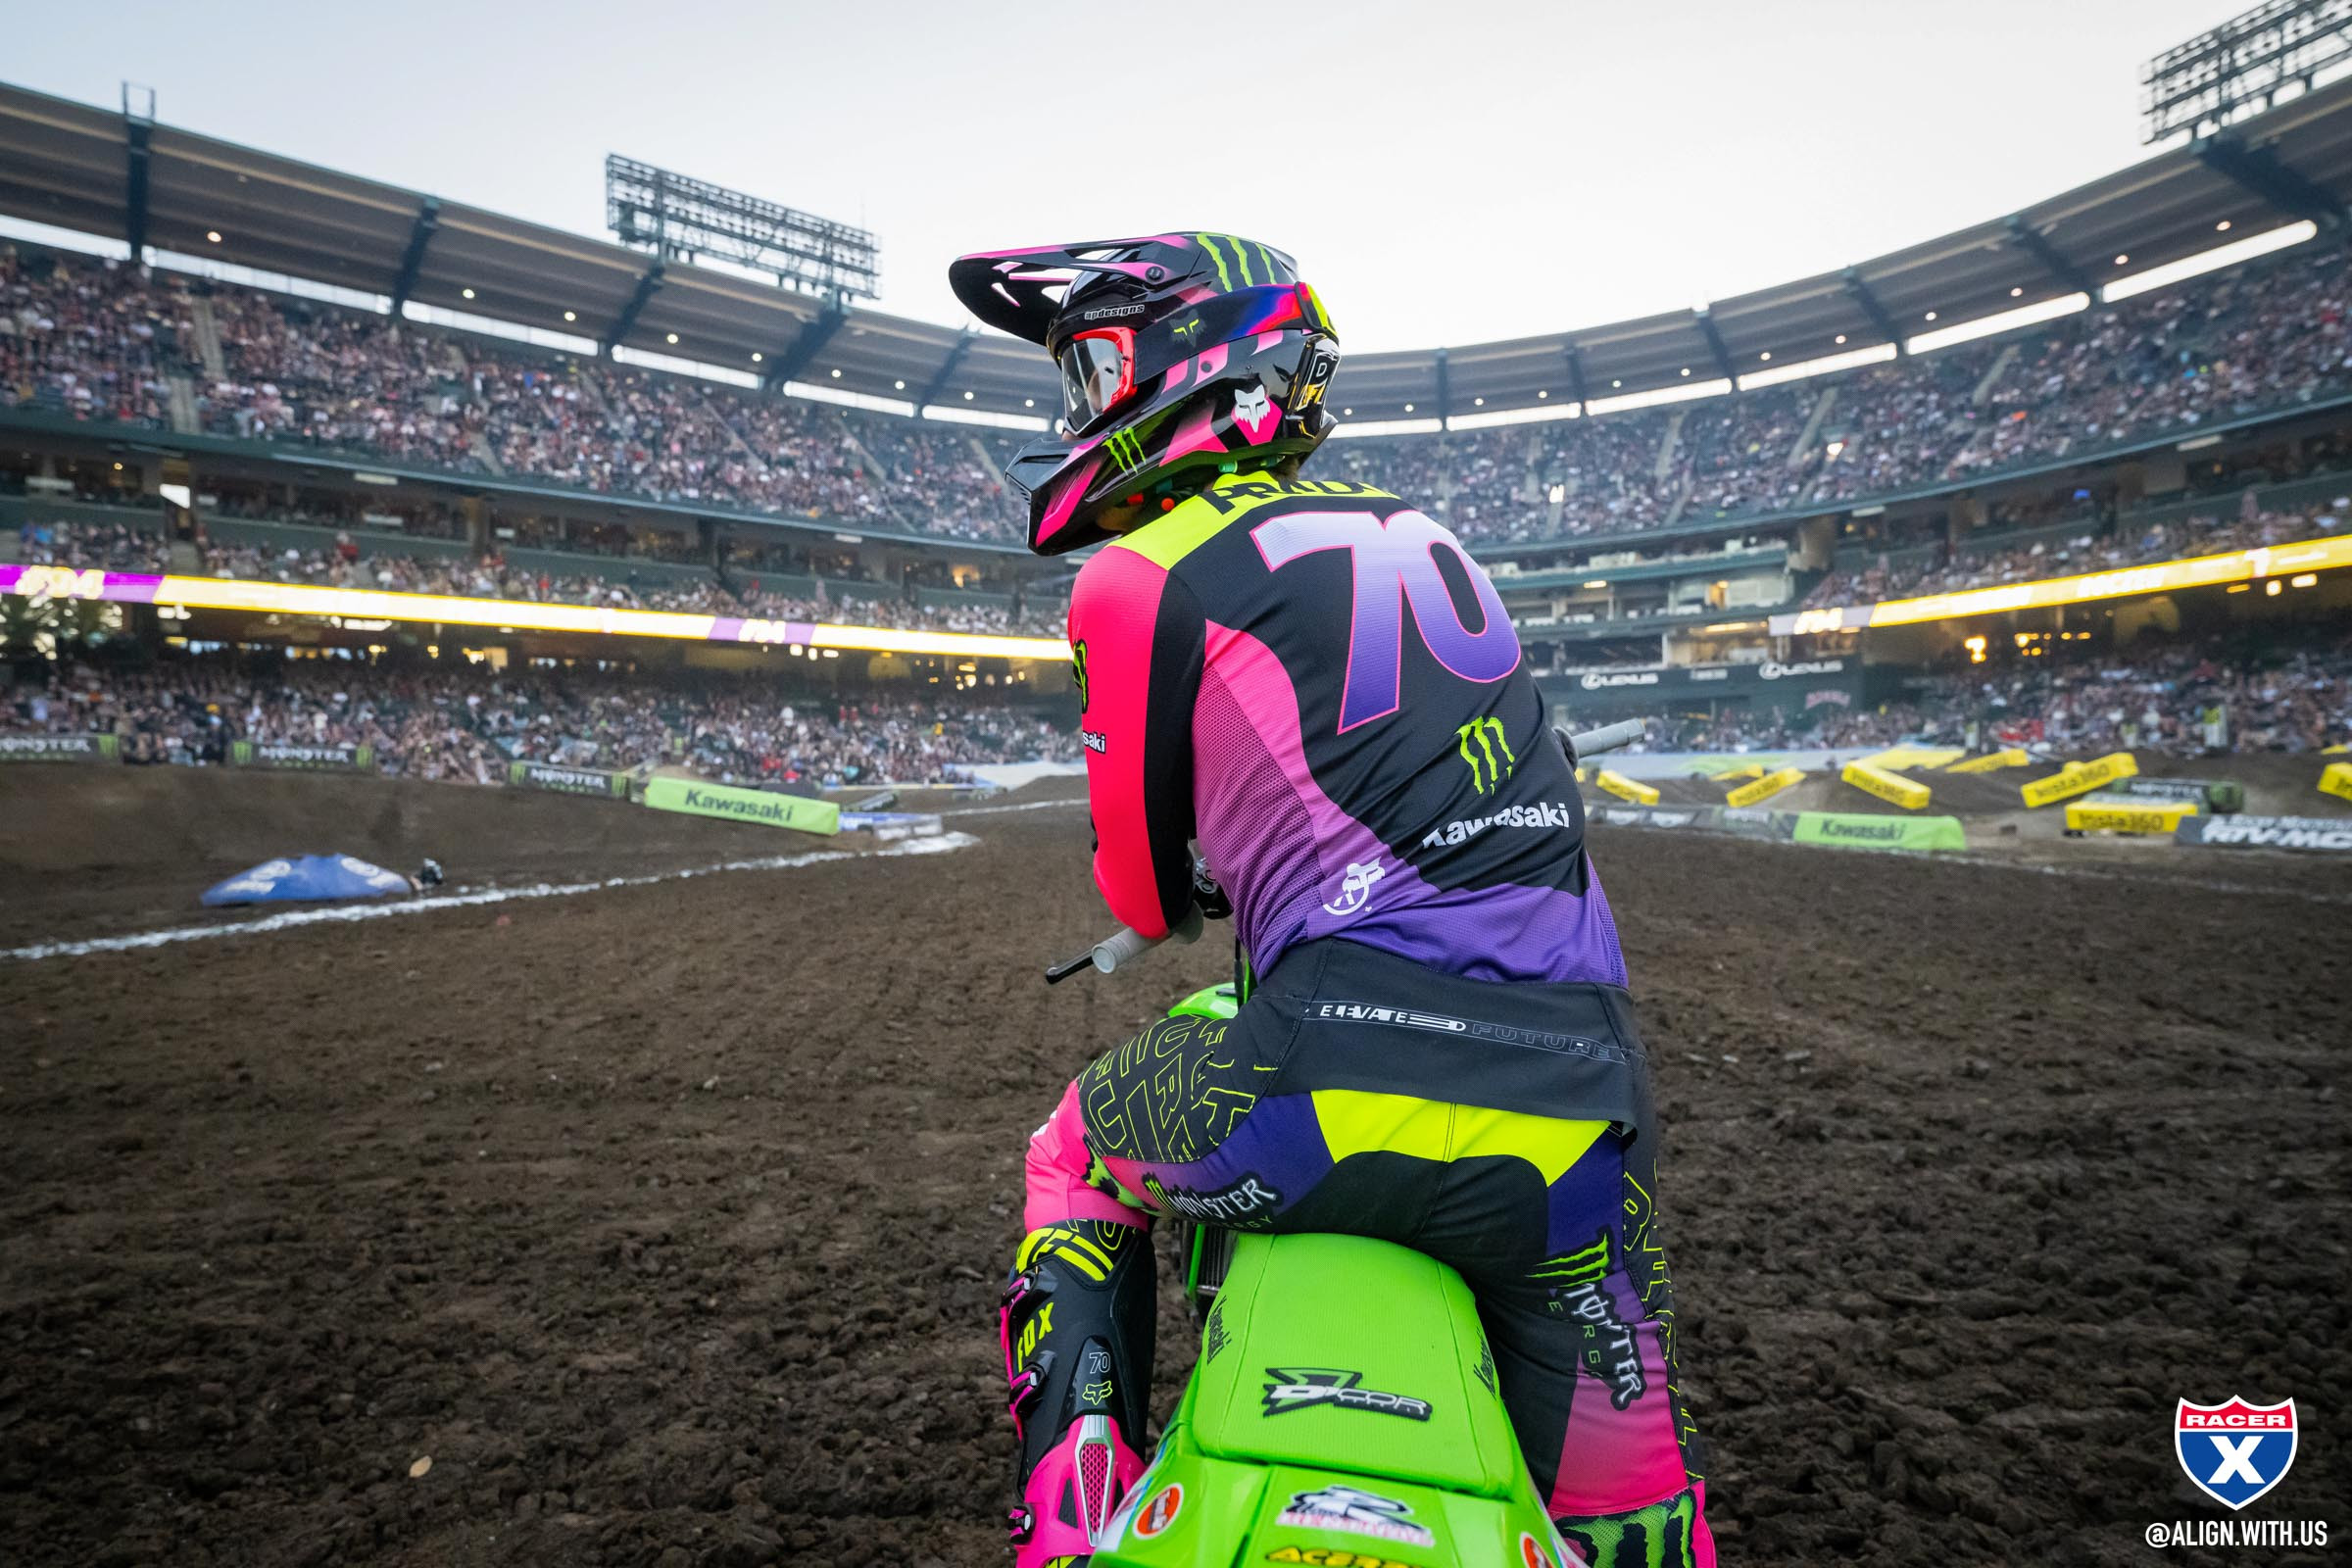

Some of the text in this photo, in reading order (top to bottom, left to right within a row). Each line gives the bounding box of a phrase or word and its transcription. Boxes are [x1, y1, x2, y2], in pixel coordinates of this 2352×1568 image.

[1084, 304, 1146, 320] apdesigns
[1250, 509, 1521, 735] 70
[1083, 732, 1105, 753] saki
[685, 788, 794, 822] Kawasaki
[1820, 819, 1907, 841] Kawasaki
[1166, 1179, 1277, 1220] MONSTER
[1089, 1351, 1111, 1375] 70
